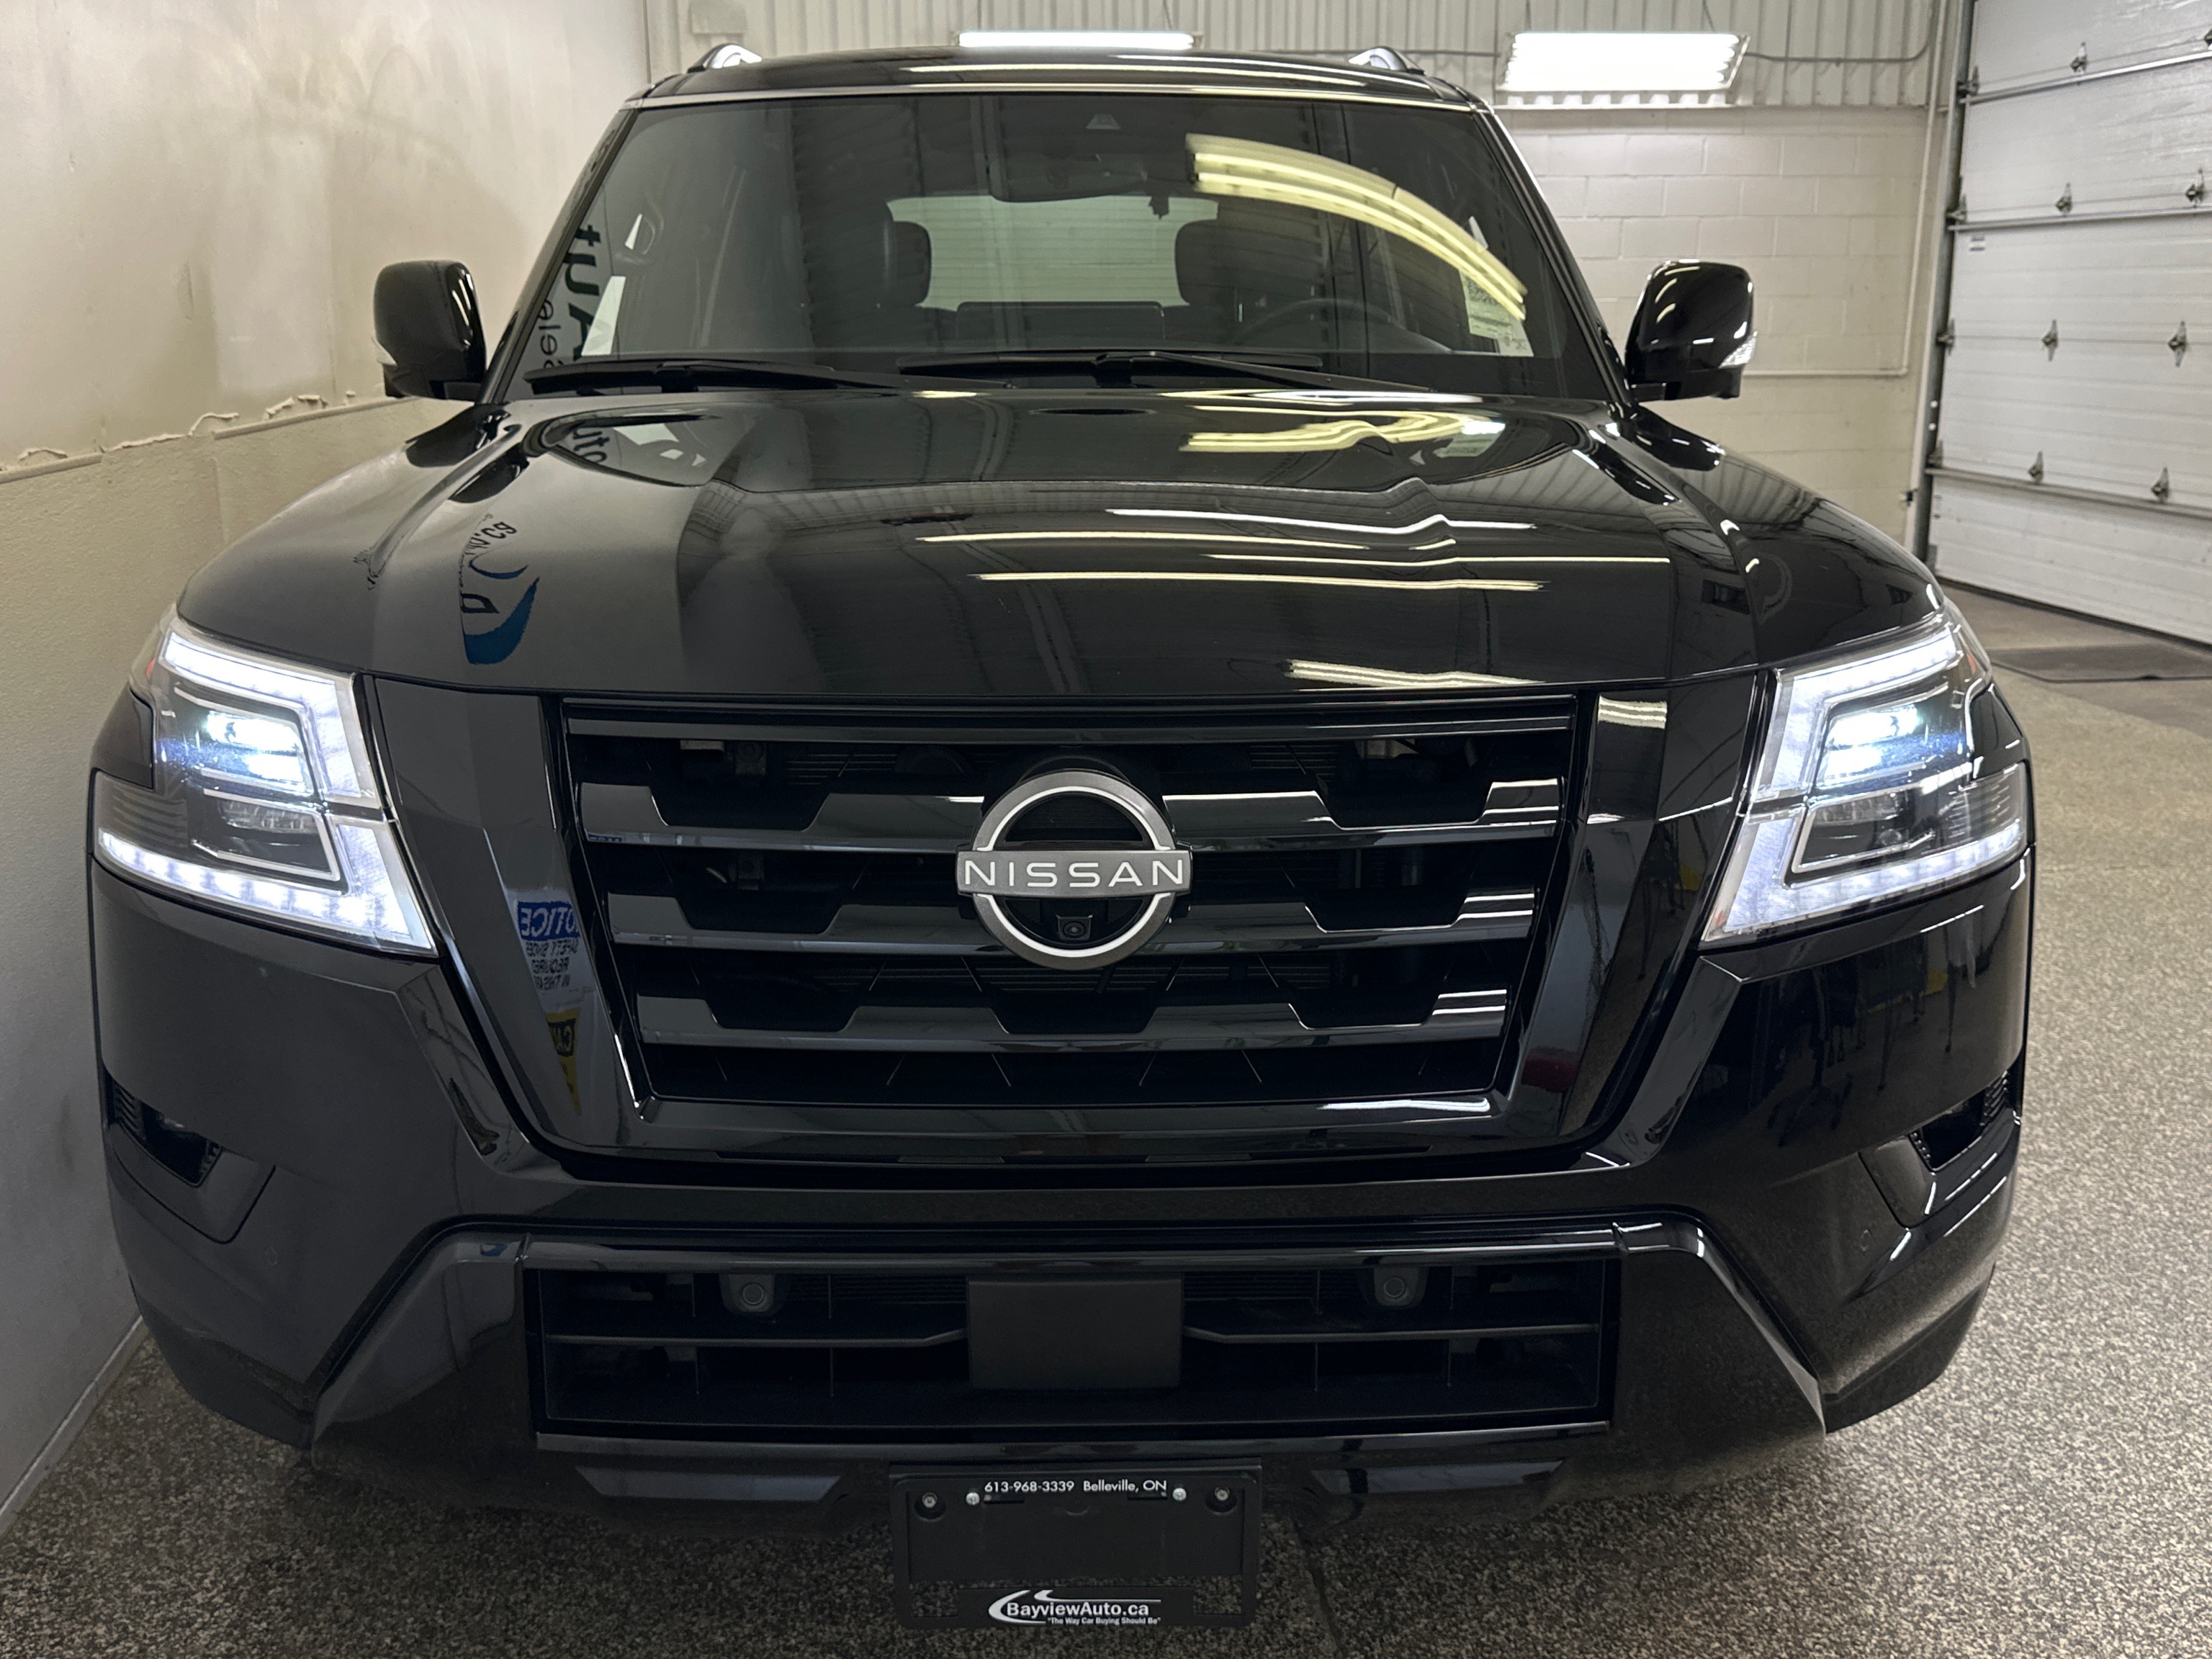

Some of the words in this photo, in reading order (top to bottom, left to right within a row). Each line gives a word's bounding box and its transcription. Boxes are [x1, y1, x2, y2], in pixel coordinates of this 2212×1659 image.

[964, 859, 1183, 888] NISSAN
[984, 1480, 1075, 1493] 613-968-3339
[1083, 1479, 1139, 1493] Belleville,
[1143, 1480, 1167, 1491] ON
[1007, 1601, 1149, 1619] BayviewAuto.ca
[1095, 1617, 1120, 1626] Buying
